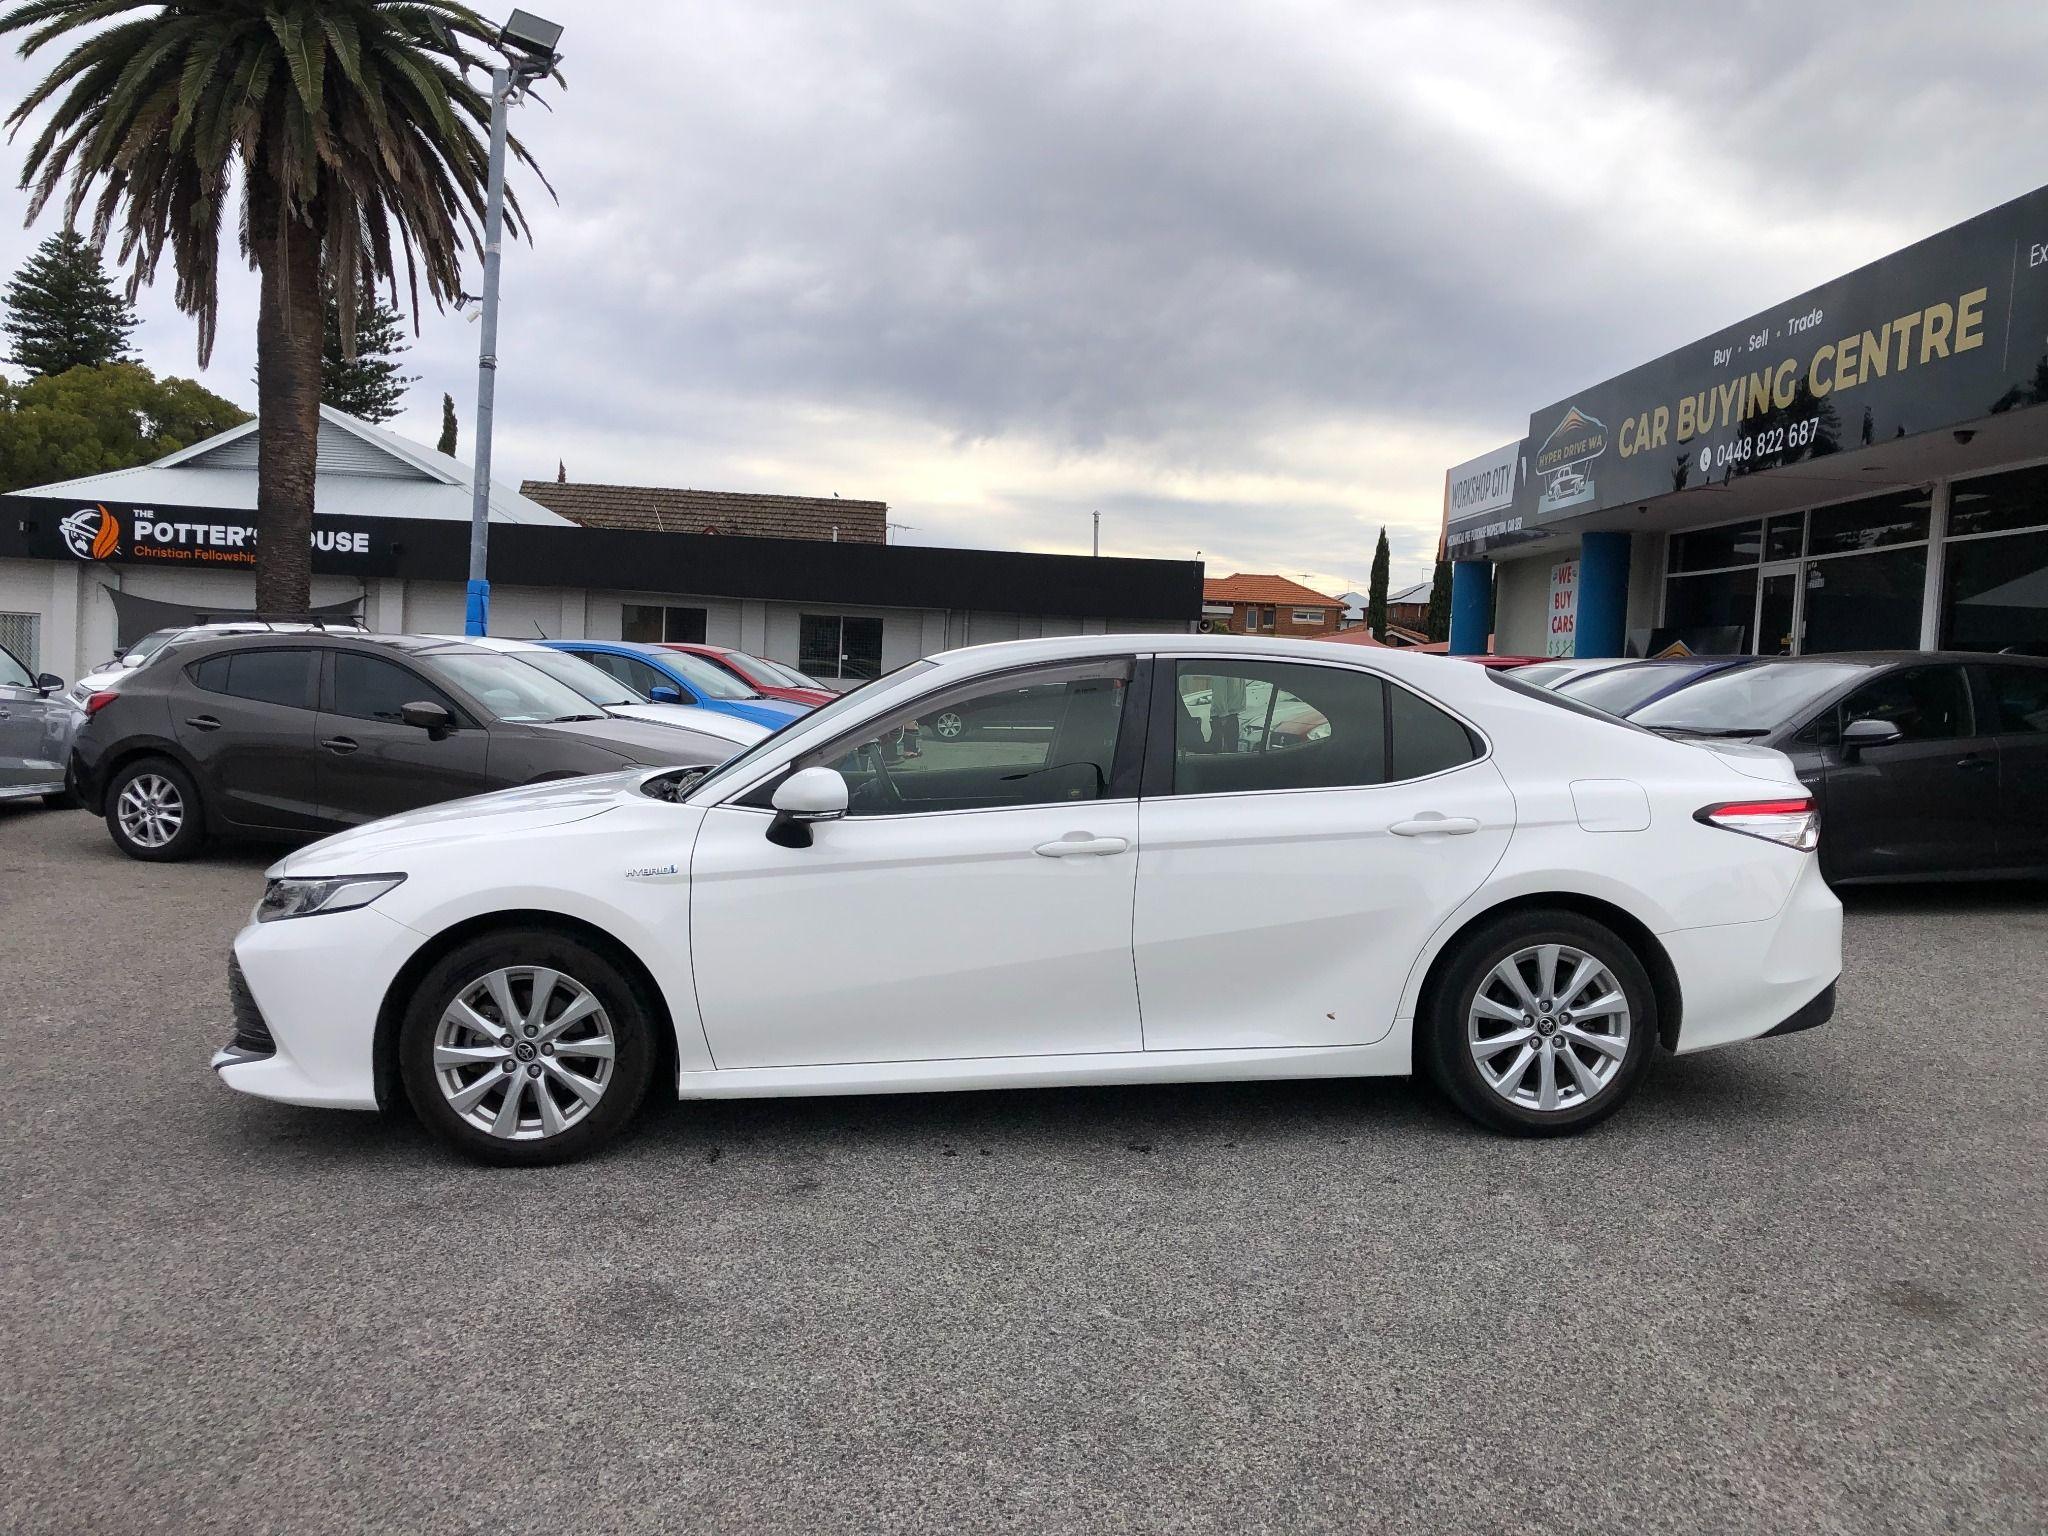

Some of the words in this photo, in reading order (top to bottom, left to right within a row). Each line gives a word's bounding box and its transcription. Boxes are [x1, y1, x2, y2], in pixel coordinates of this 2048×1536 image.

[1713, 346, 1733, 367] Buy
[1748, 328, 1769, 352] Sell
[1787, 307, 1824, 336] Trade
[1618, 405, 1669, 458] CAR
[1676, 358, 1798, 442] BUYING
[1808, 287, 1988, 398] CENTRE
[1539, 448, 1562, 468] HYPER
[1563, 439, 1587, 458] DRIVE
[1588, 434, 1603, 450] WA
[1717, 437, 1752, 467] 0448
[1756, 427, 1784, 457] 822
[1788, 416, 1820, 448] 687
[1452, 470, 1491, 510] WORKSHOP
[1491, 463, 1512, 498] CITY
[133, 509, 154, 519] THE
[310, 530, 369, 553] USE
[134, 545, 192, 559] Christian
[194, 548, 257, 563] Fellowship
[1558, 566, 1572, 584] WE
[1554, 591, 1572, 609] BUY
[1552, 614, 1574, 633] CARS
[625, 866, 672, 877] HYBRID
